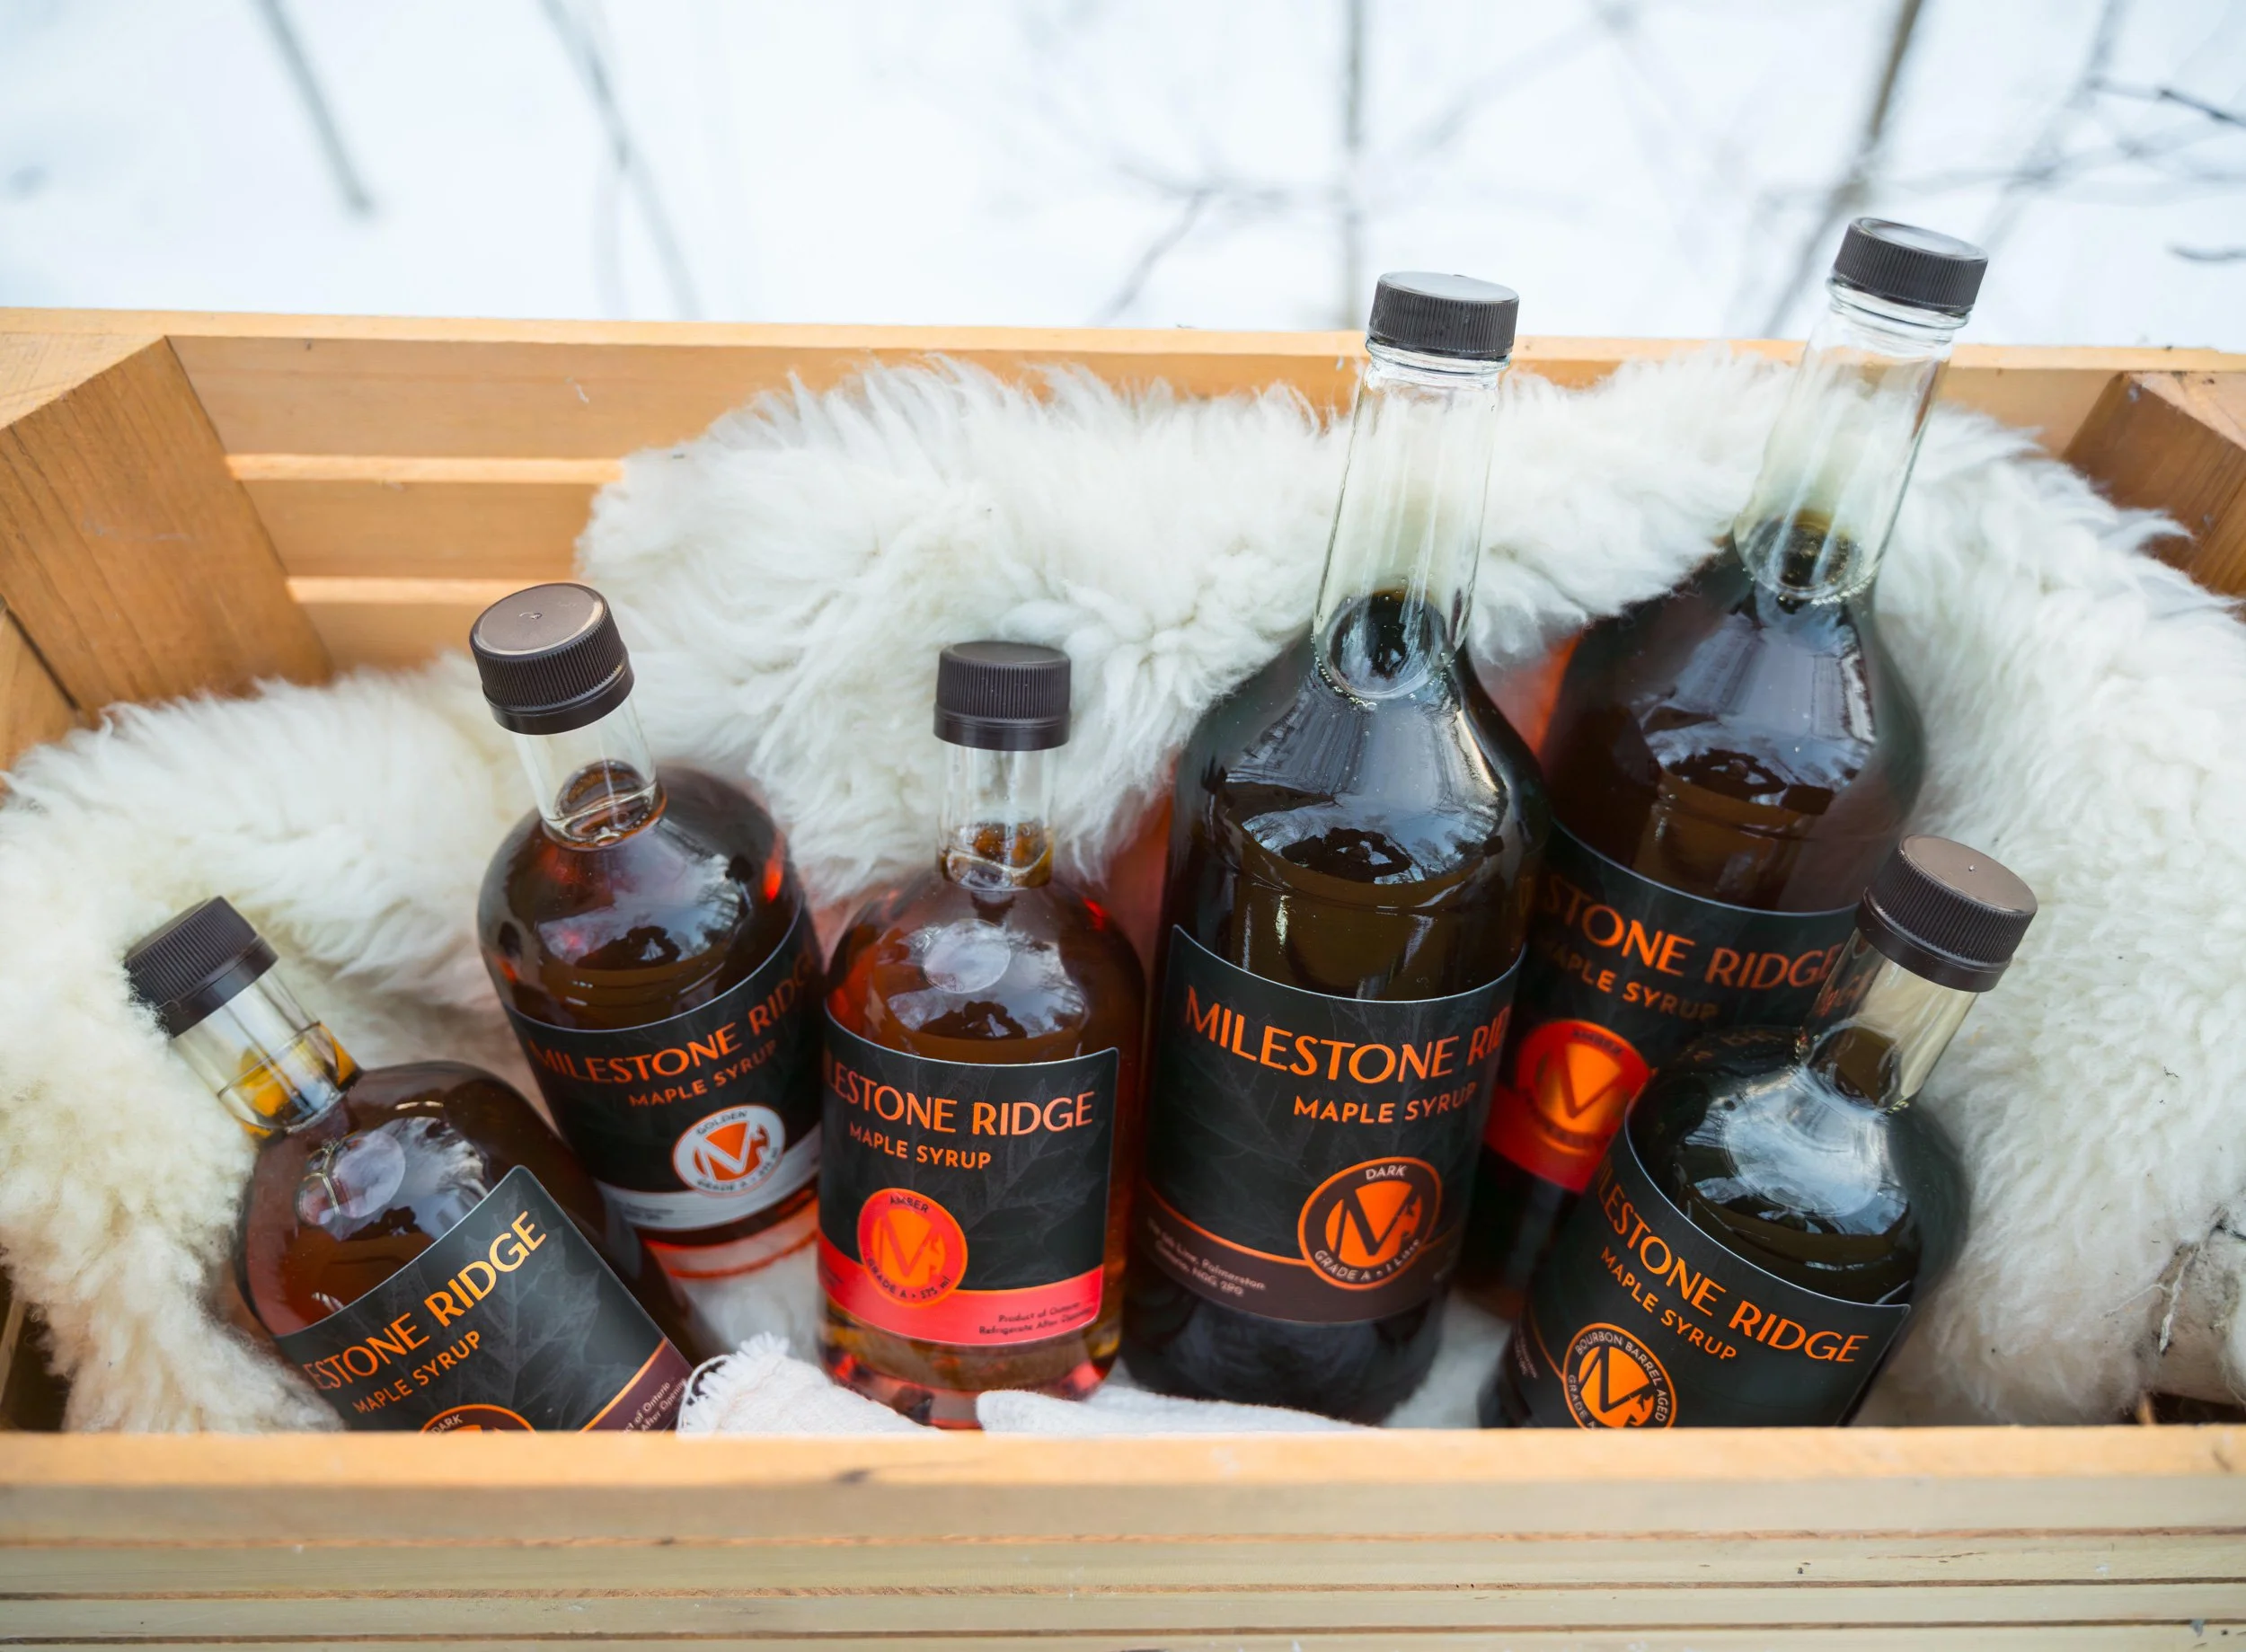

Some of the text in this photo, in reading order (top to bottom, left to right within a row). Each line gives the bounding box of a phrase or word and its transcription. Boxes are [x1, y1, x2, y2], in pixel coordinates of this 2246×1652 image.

[1622, 981, 1720, 1021] SYRUP
[526, 1021, 743, 1084] MILESTONE
[1185, 985, 1460, 1085] MILESTONE
[628, 1038, 777, 1108] MAPLE SYRUP
[696, 1109, 748, 1135] GOLDEN
[972, 1091, 1096, 1136] RIDGE
[1293, 1081, 1478, 1125] MAPLE SYRUP
[849, 1120, 992, 1171] MAPLE SYRUP
[1366, 1164, 1408, 1181] DARK
[889, 1196, 930, 1214] AMBER
[868, 1258, 897, 1294] GRADE
[899, 1289, 907, 1299] A
[1314, 1250, 1358, 1281] GRADE
[1360, 1273, 1372, 1281] A
[302, 1210, 547, 1391] ESTONE RIDGE
[1600, 1246, 1738, 1361] MAPLE SYRUP
[1728, 1299, 1870, 1364] RIDGE
[351, 1330, 482, 1414] MAPLE SYRUP
[1575, 1330, 1624, 1356] BOURBON
[1625, 1341, 1663, 1386] BARREL
[1655, 1389, 1669, 1422] AGED
[641, 1382, 671, 1413] Ontario
[1568, 1374, 1588, 1418] GRADE
